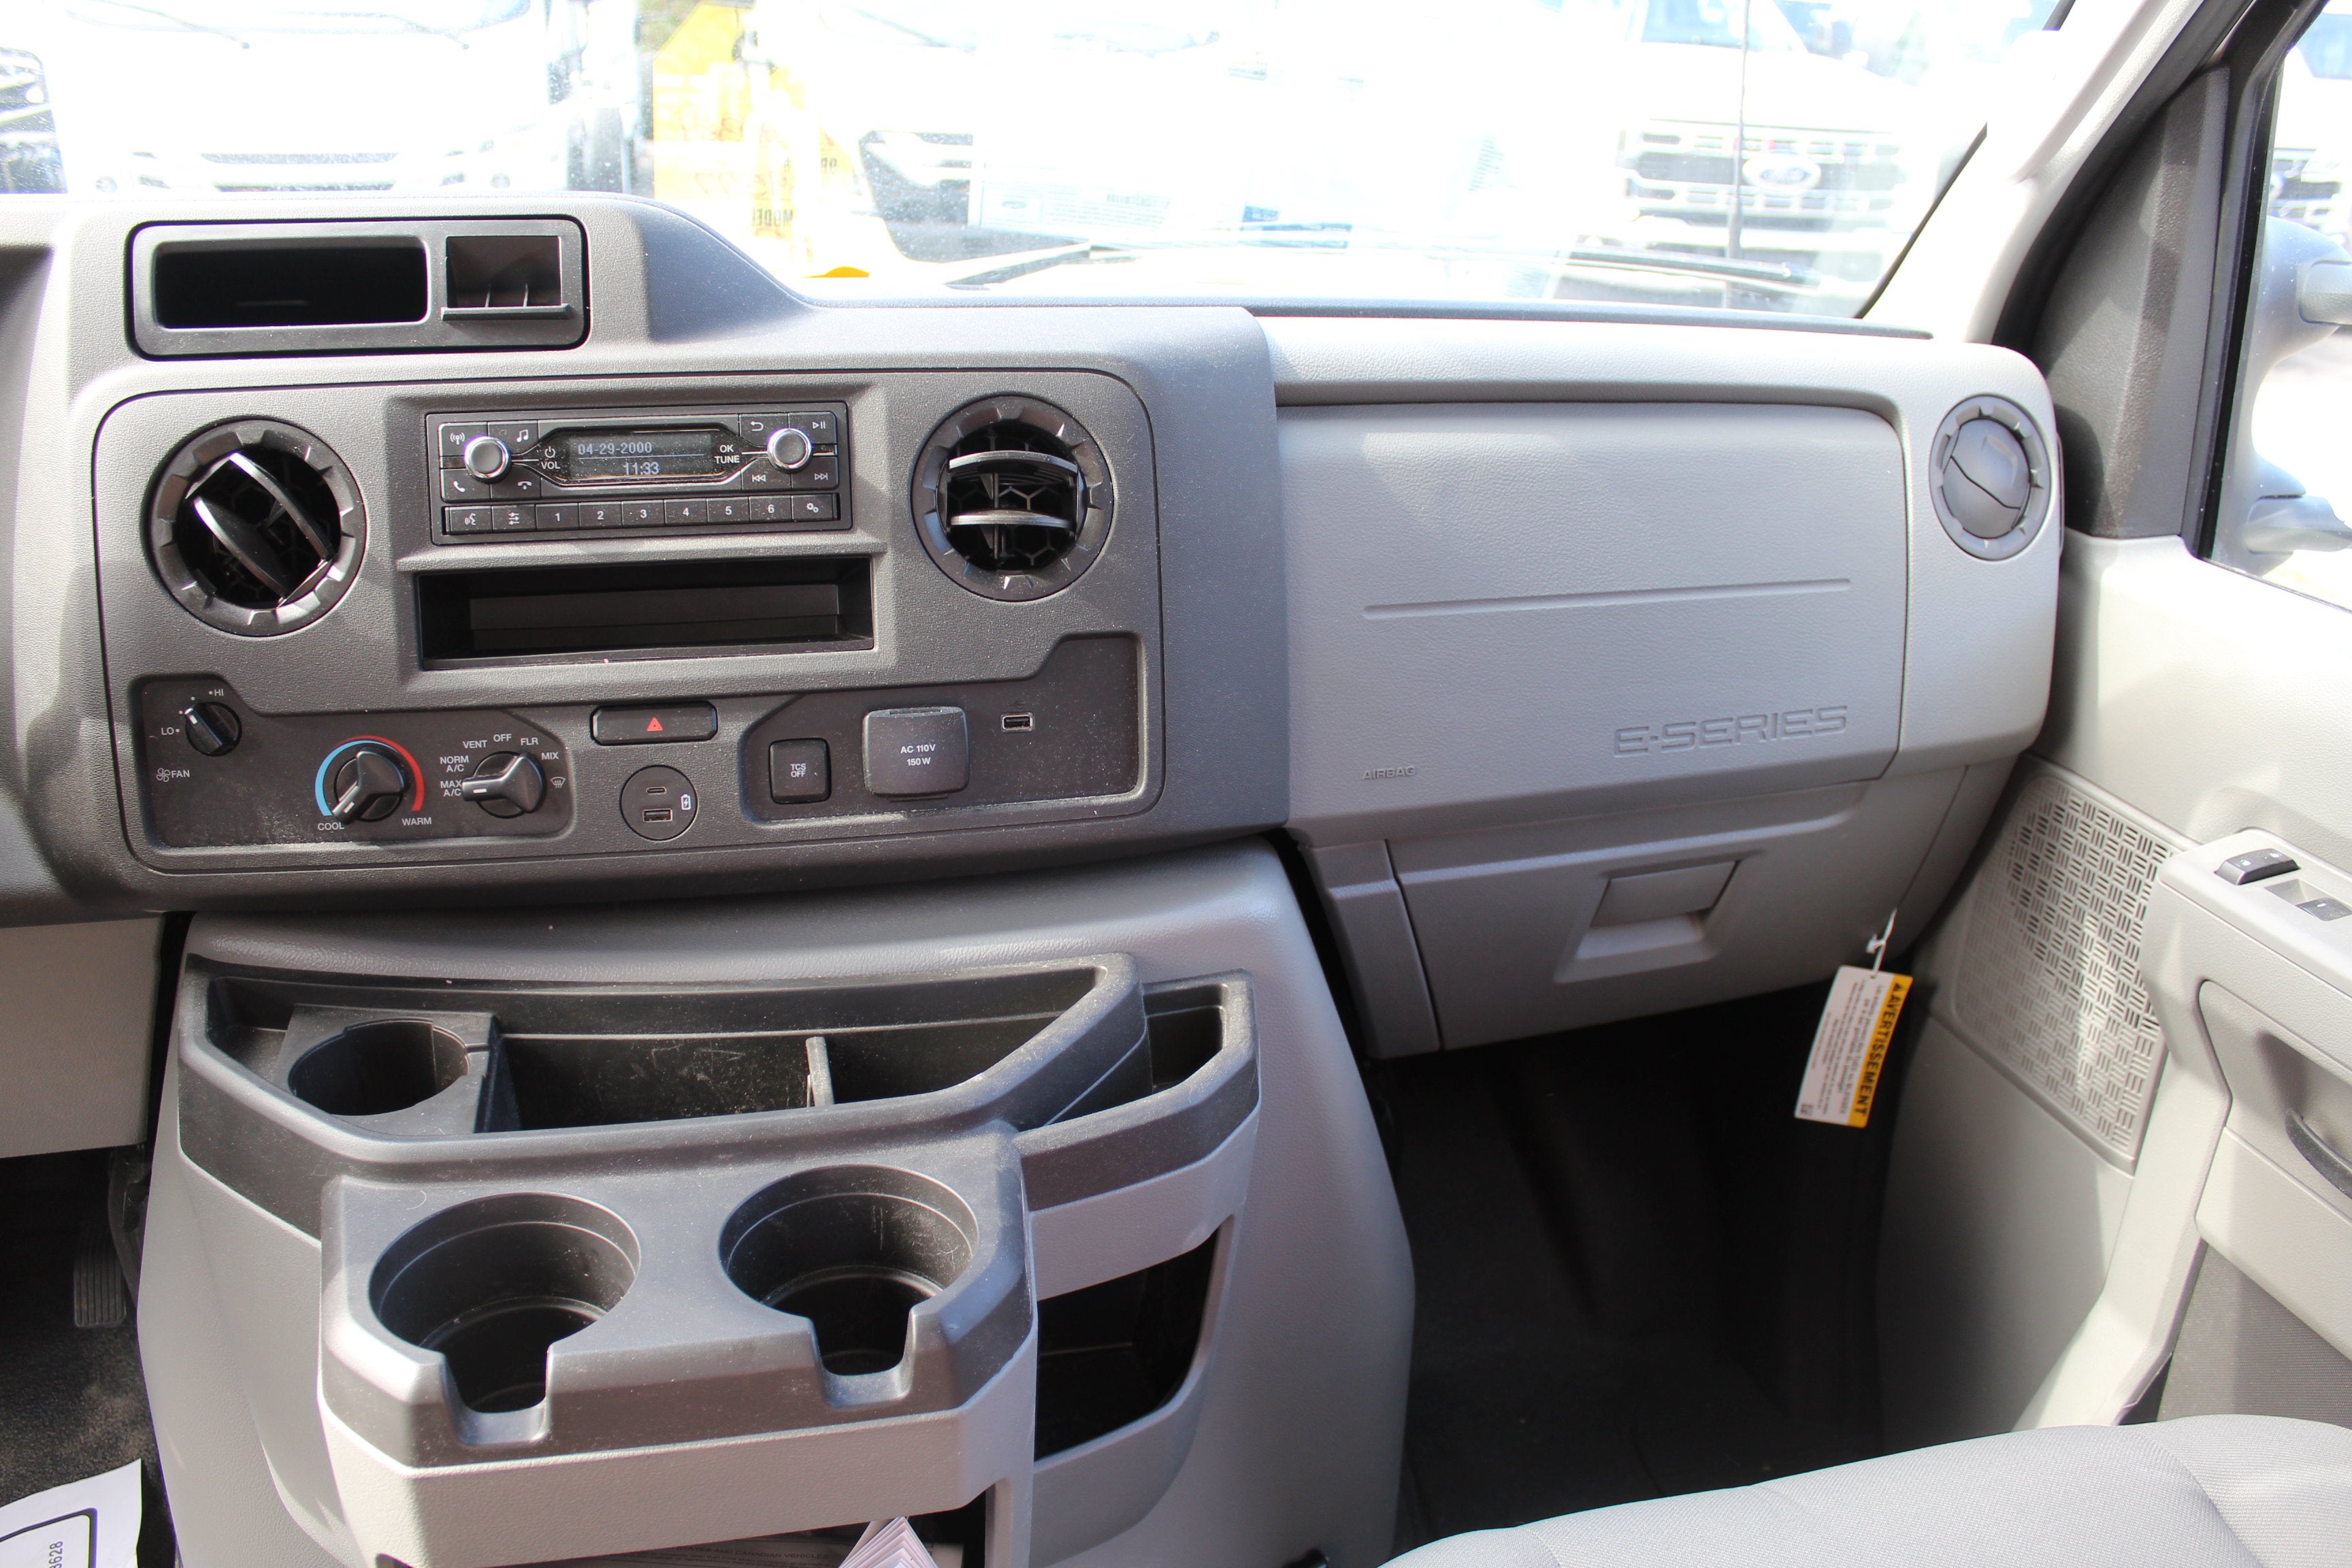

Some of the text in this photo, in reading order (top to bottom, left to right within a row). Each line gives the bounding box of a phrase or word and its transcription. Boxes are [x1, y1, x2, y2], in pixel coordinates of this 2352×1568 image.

[578, 442, 653, 456] 04-29-2000
[719, 444, 734, 453] OK
[715, 455, 740, 464] TUNE
[541, 461, 560, 470] VOL
[623, 461, 659, 475] 11:33
[640, 509, 647, 519] 3
[682, 508, 689, 517] 4
[725, 506, 732, 515] 5
[767, 504, 775, 514] 6
[597, 510, 604, 520] 2
[214, 689, 224, 697] HI
[161, 728, 174, 736] LO
[1614, 705, 1849, 758] E-SERIES
[493, 734, 512, 742] OFF
[520, 737, 538, 747] FLR
[462, 740, 488, 749] VENT
[900, 744, 936, 754] AC 110V
[440, 755, 470, 765] NORM
[541, 751, 559, 761] MIX
[446, 764, 465, 773] A/C
[790, 763, 806, 771] TCS
[171, 770, 191, 779] FAN
[790, 770, 806, 778] OFF
[1362, 766, 1416, 781] AIRBAG
[440, 779, 462, 789] MAX
[443, 788, 462, 798] A/C
[317, 822, 345, 832] COOL
[402, 817, 432, 827] WARM
[1855, 995, 1901, 1116] AVERTISSEMENT
